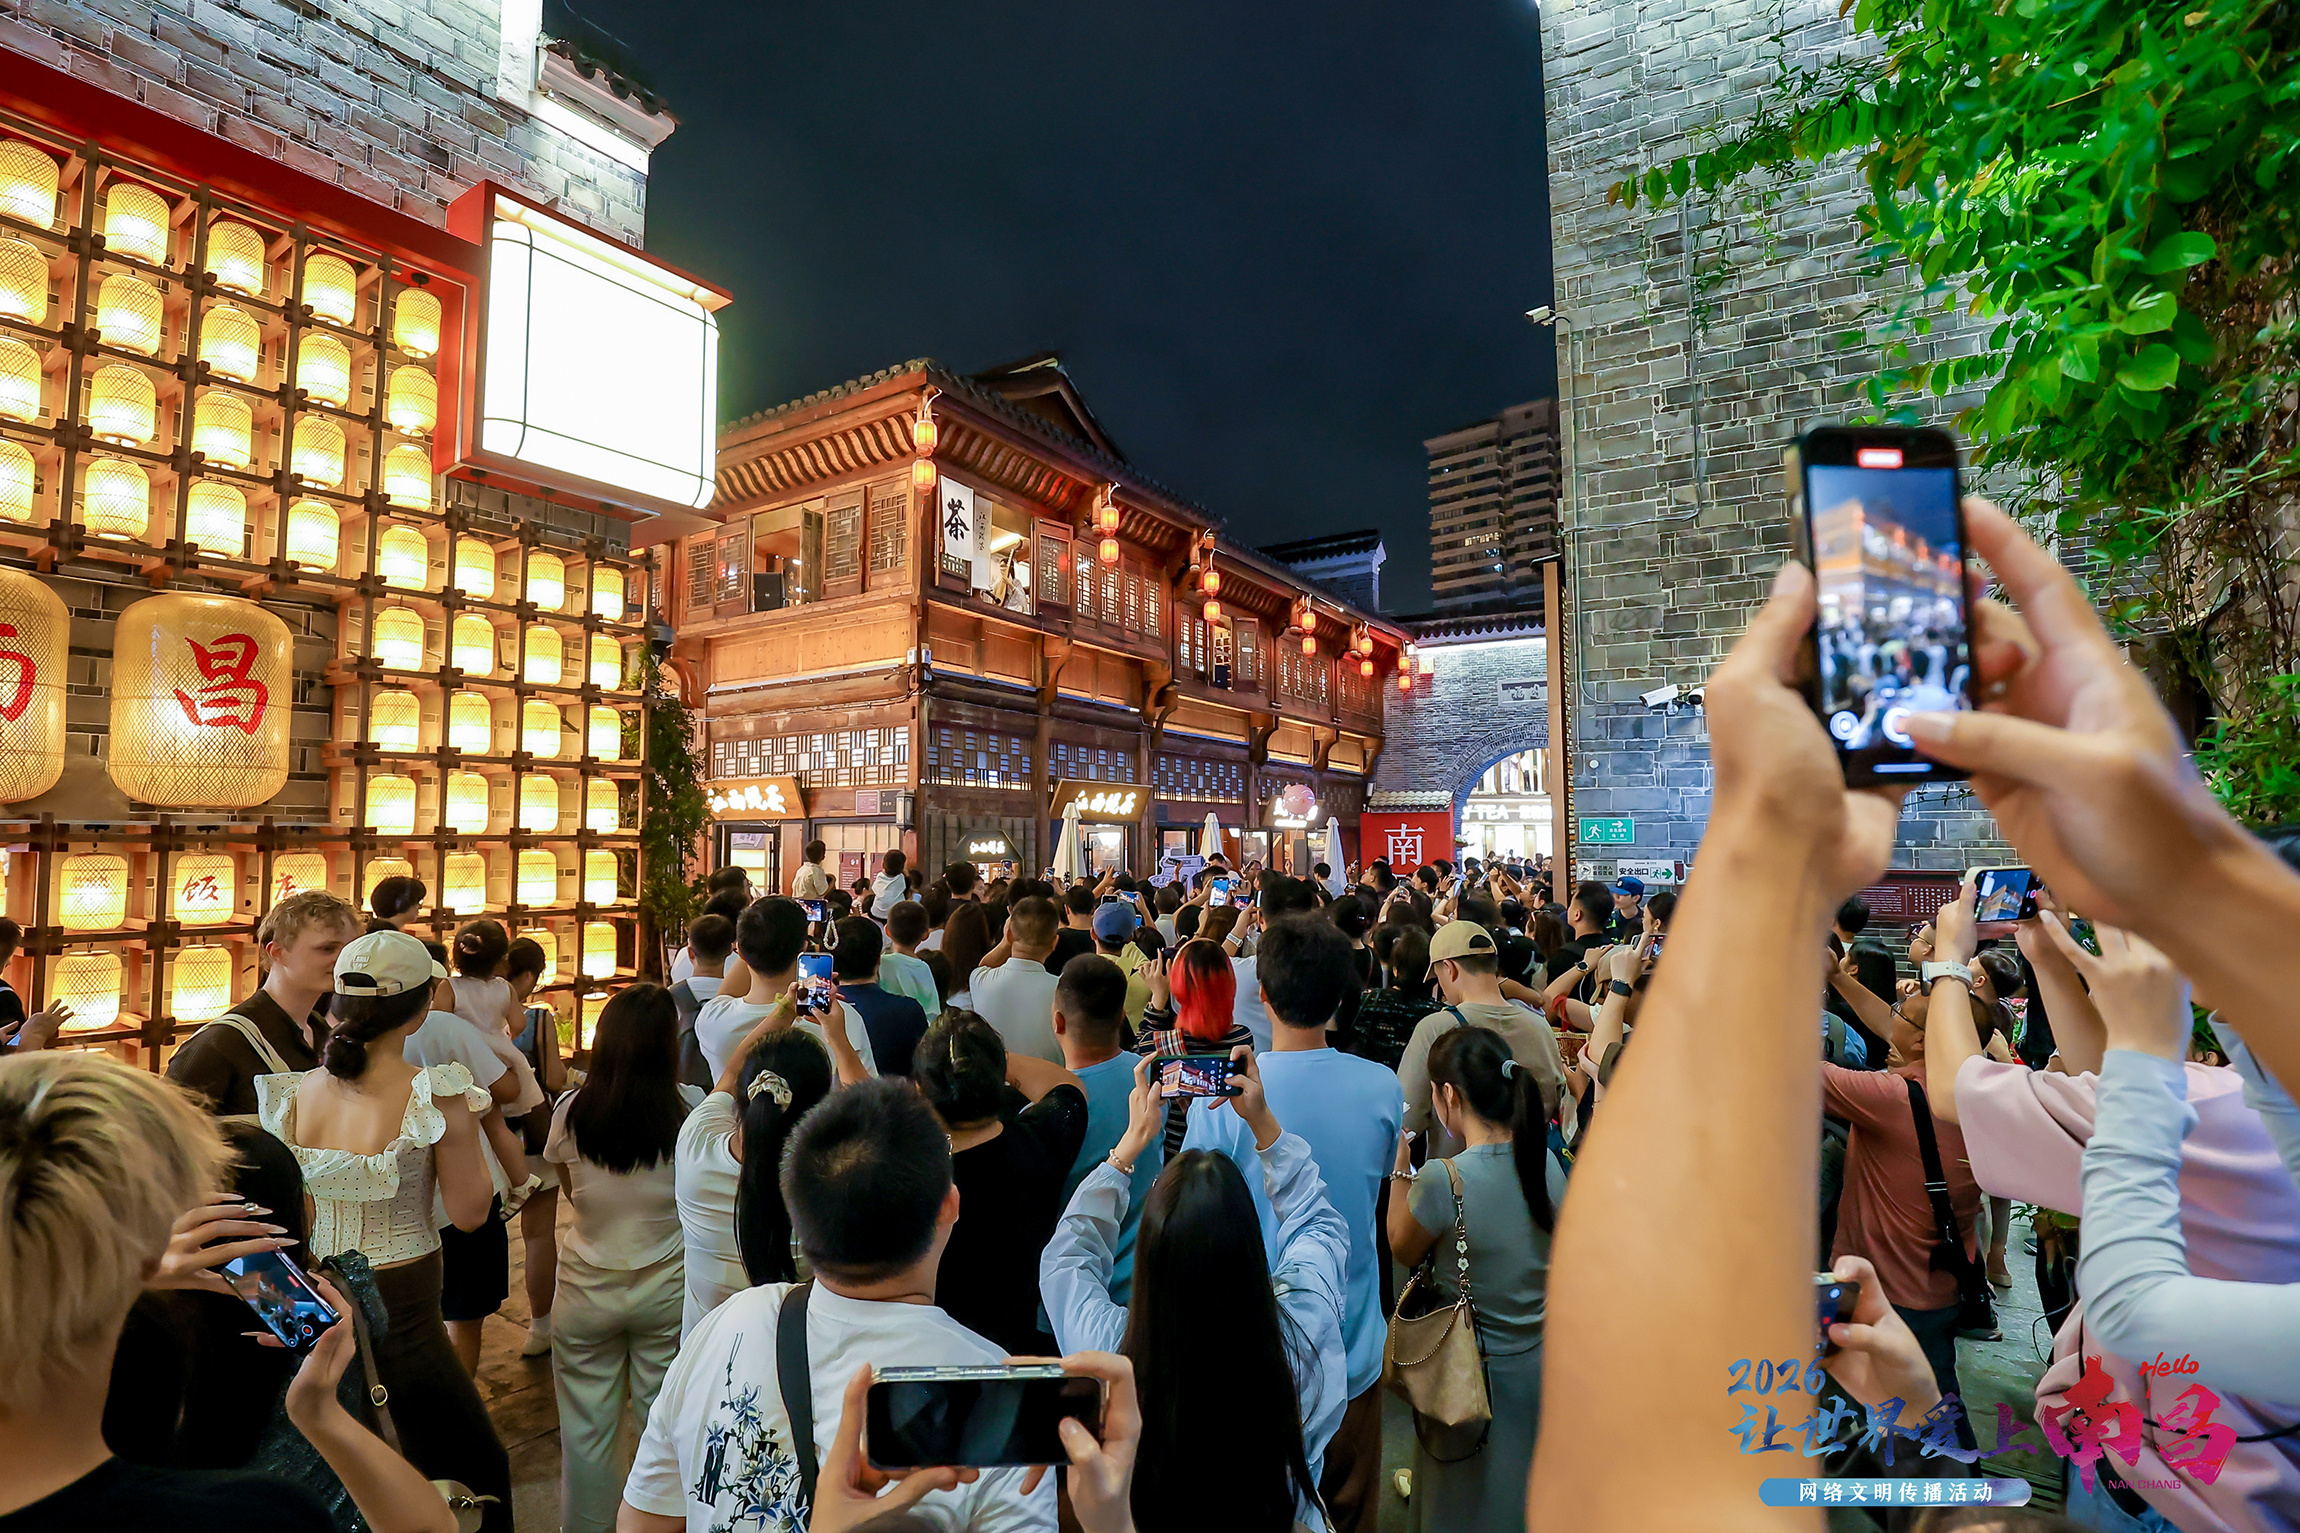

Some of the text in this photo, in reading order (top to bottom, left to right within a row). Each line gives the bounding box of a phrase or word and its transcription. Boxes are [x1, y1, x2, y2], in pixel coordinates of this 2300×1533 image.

[944, 497, 970, 541] 茶
[173, 633, 269, 735] 昌
[1474, 804, 1509, 820] TEA
[1384, 823, 1425, 866] 南
[182, 875, 218, 902] 饭
[1619, 867, 1649, 876] 安全出口
